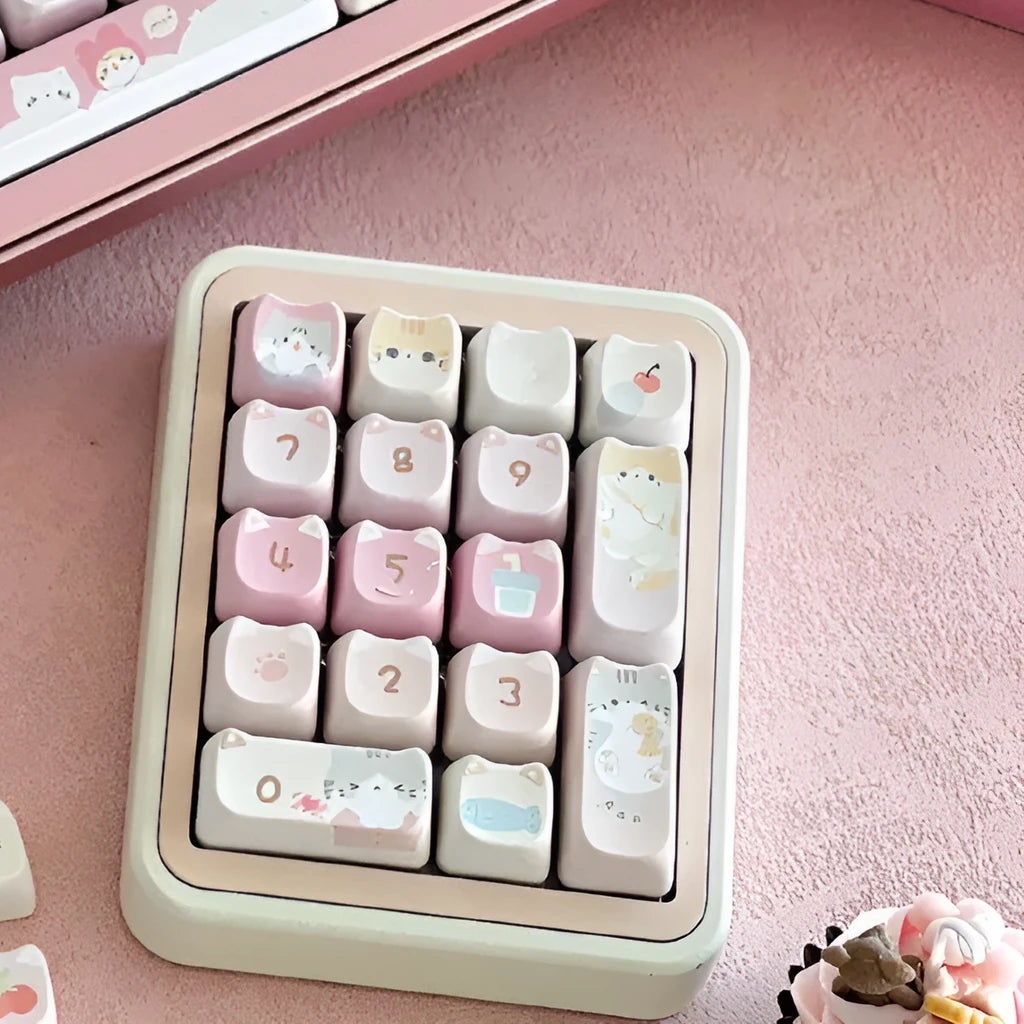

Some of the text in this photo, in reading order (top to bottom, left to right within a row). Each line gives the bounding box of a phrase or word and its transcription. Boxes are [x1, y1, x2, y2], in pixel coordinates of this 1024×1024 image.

[276, 433, 300, 462] 7
[392, 446, 414, 473] 8
[508, 459, 532, 488] 9
[268, 541, 294, 573] 4
[385, 553, 409, 584] 5
[377, 664, 402, 694] 2
[498, 676, 521, 707] 3
[255, 774, 282, 804] 0
